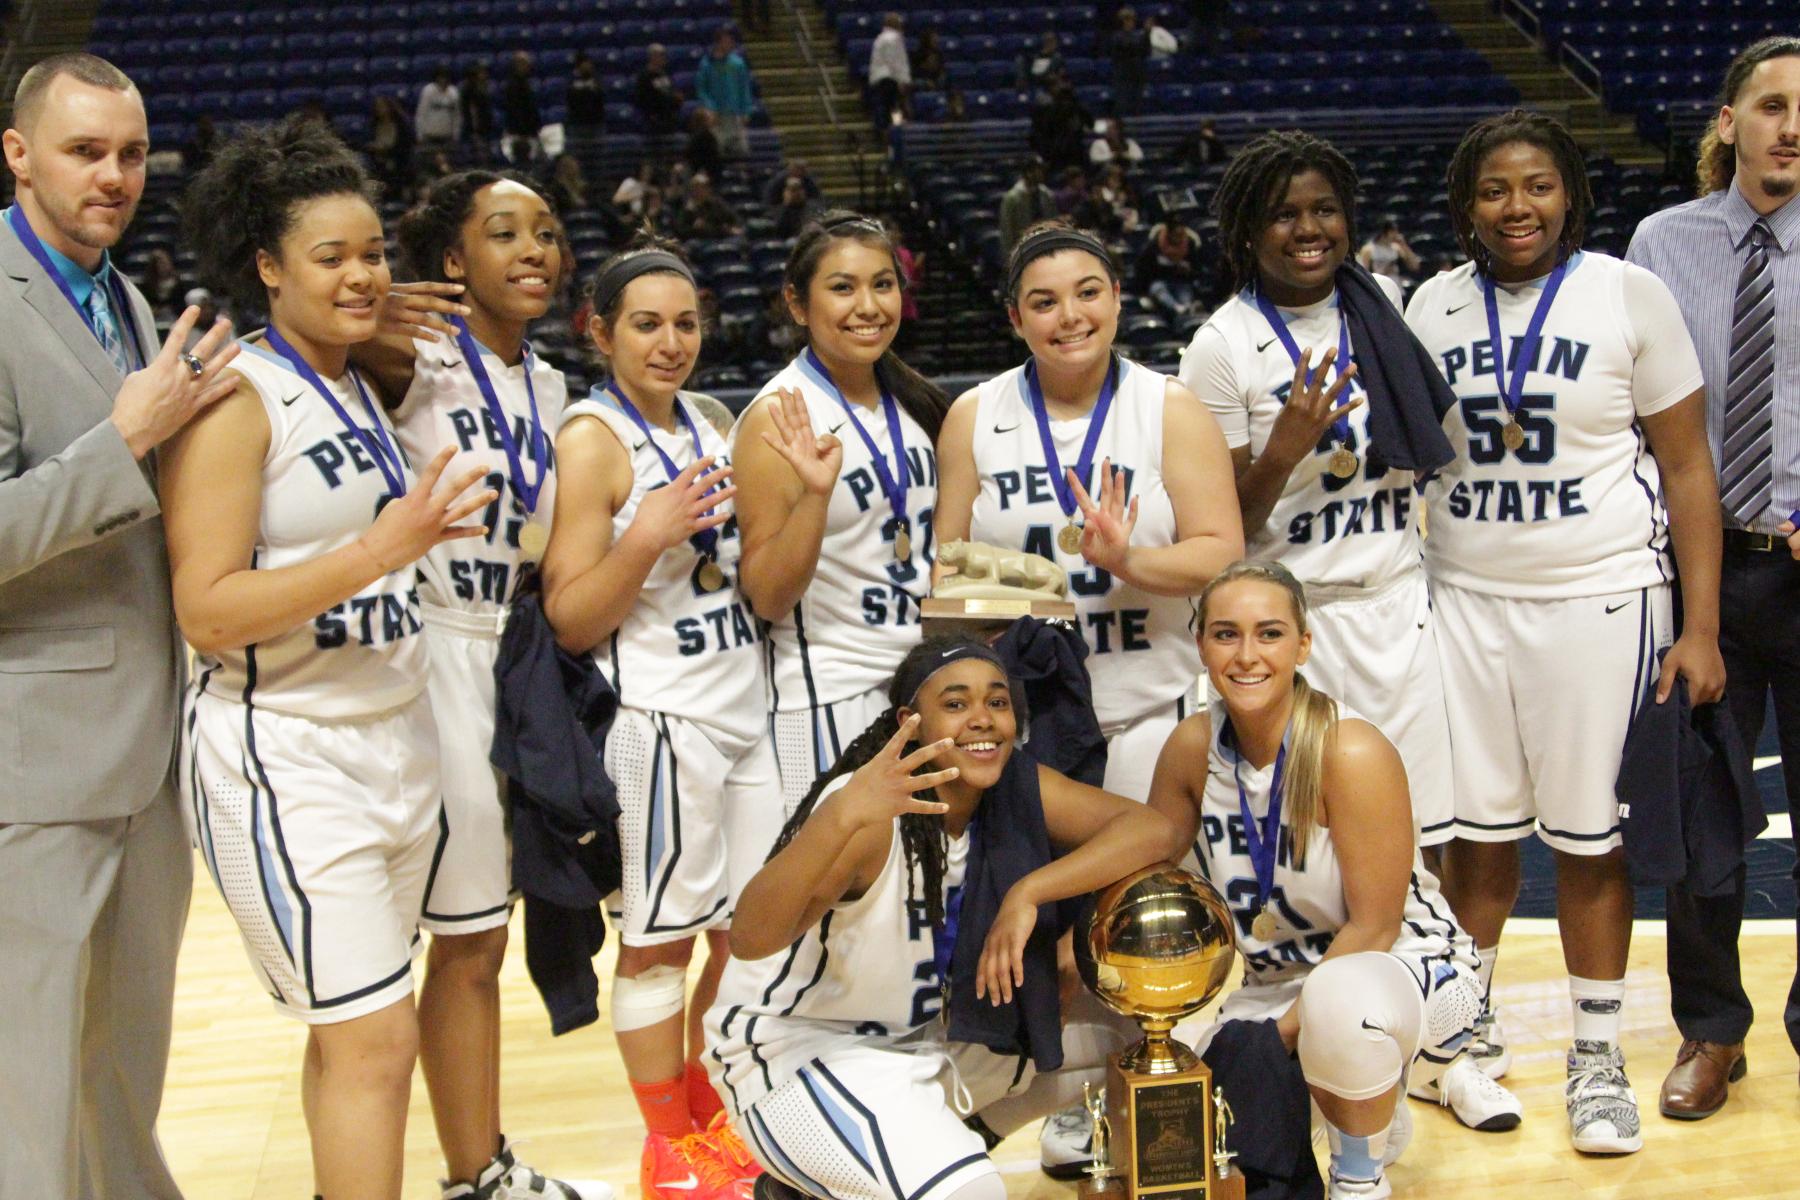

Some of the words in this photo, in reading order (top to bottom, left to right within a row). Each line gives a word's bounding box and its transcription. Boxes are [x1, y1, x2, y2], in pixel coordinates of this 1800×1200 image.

[1459, 392, 1557, 466] 55
[1287, 487, 1411, 544] STATE
[1448, 477, 1589, 523] STATE
